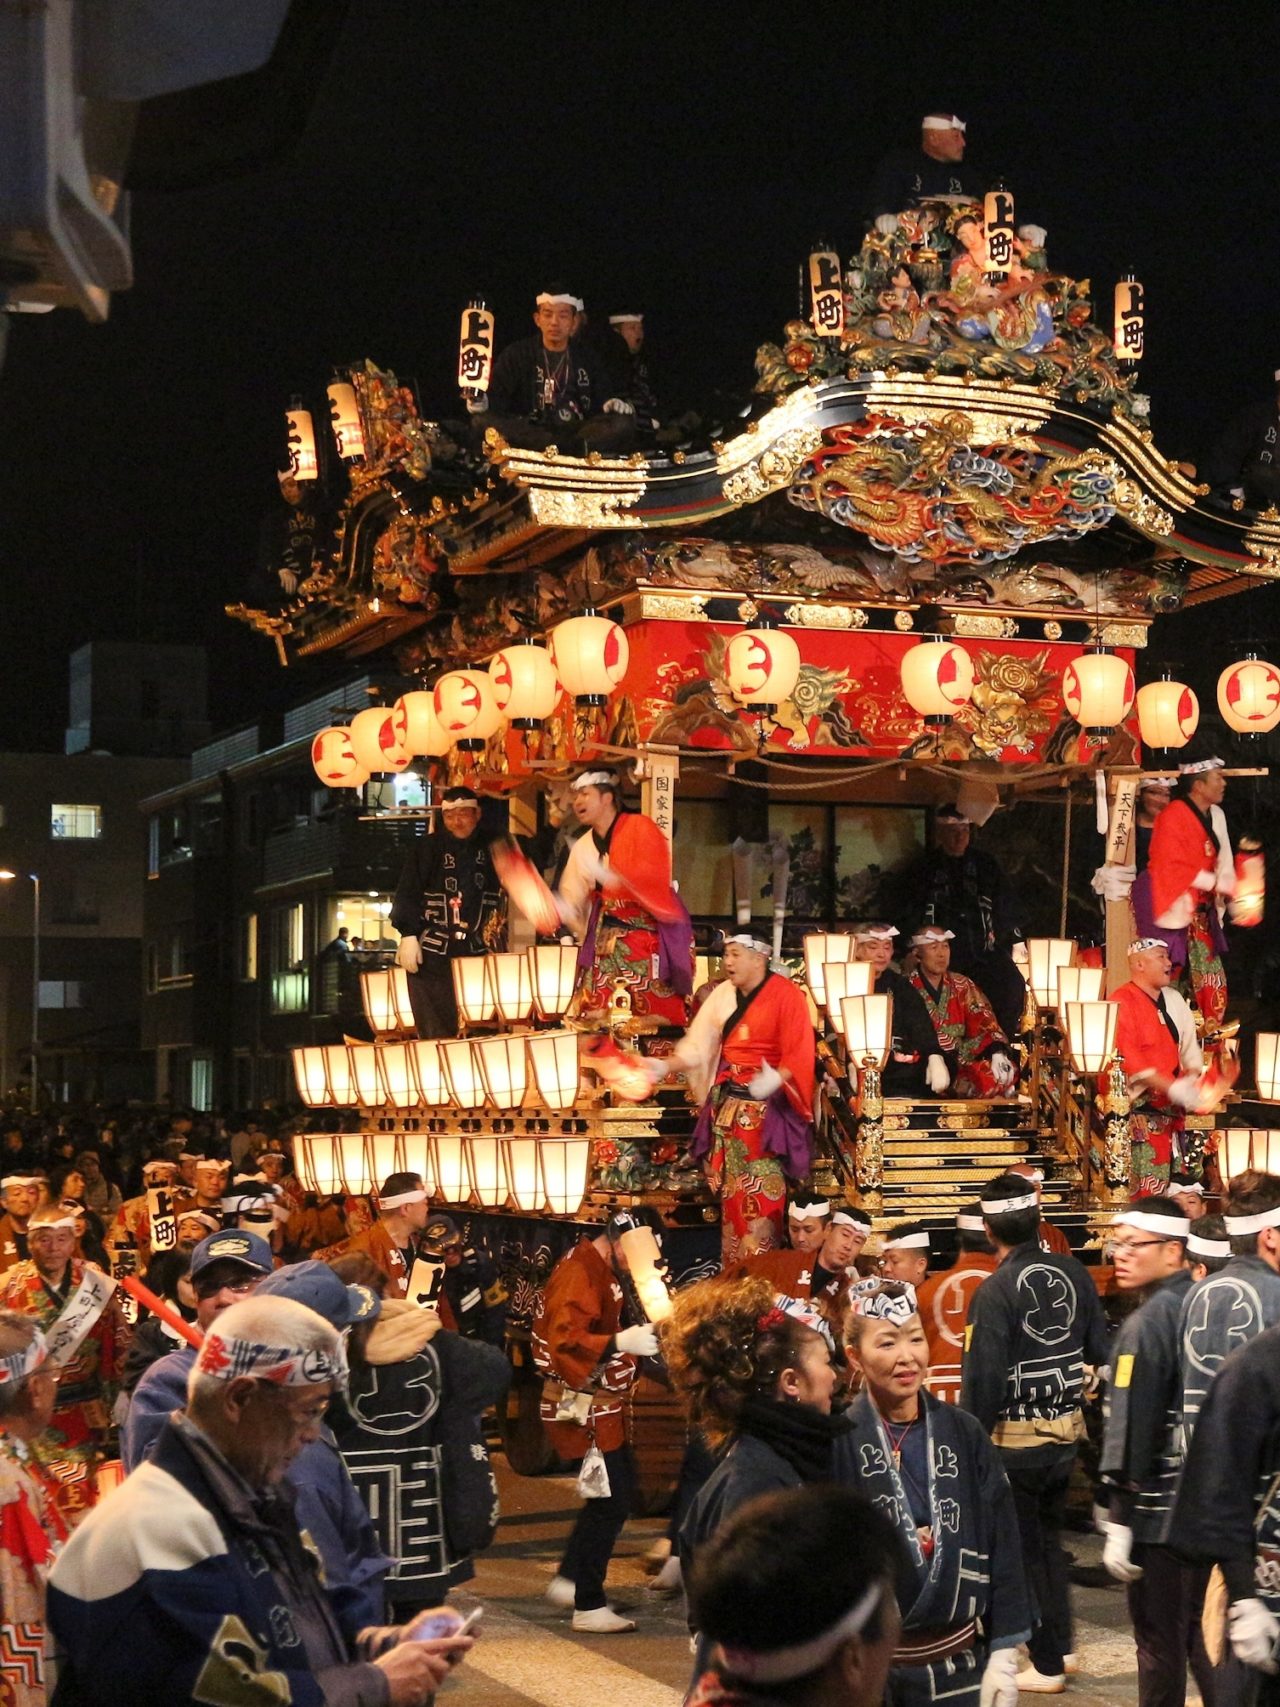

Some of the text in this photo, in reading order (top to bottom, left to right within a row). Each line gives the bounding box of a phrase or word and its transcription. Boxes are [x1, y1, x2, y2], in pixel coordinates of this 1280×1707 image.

[989, 194, 1013, 266] 上町
[814, 256, 841, 330] 上町
[1121, 285, 1143, 353] 上町
[462, 311, 489, 381] 上町
[656, 776, 669, 841] 国家安
[1112, 793, 1132, 850] 天下泰平
[152, 1191, 176, 1247] 上町
[936, 1445, 960, 1533] 上町
